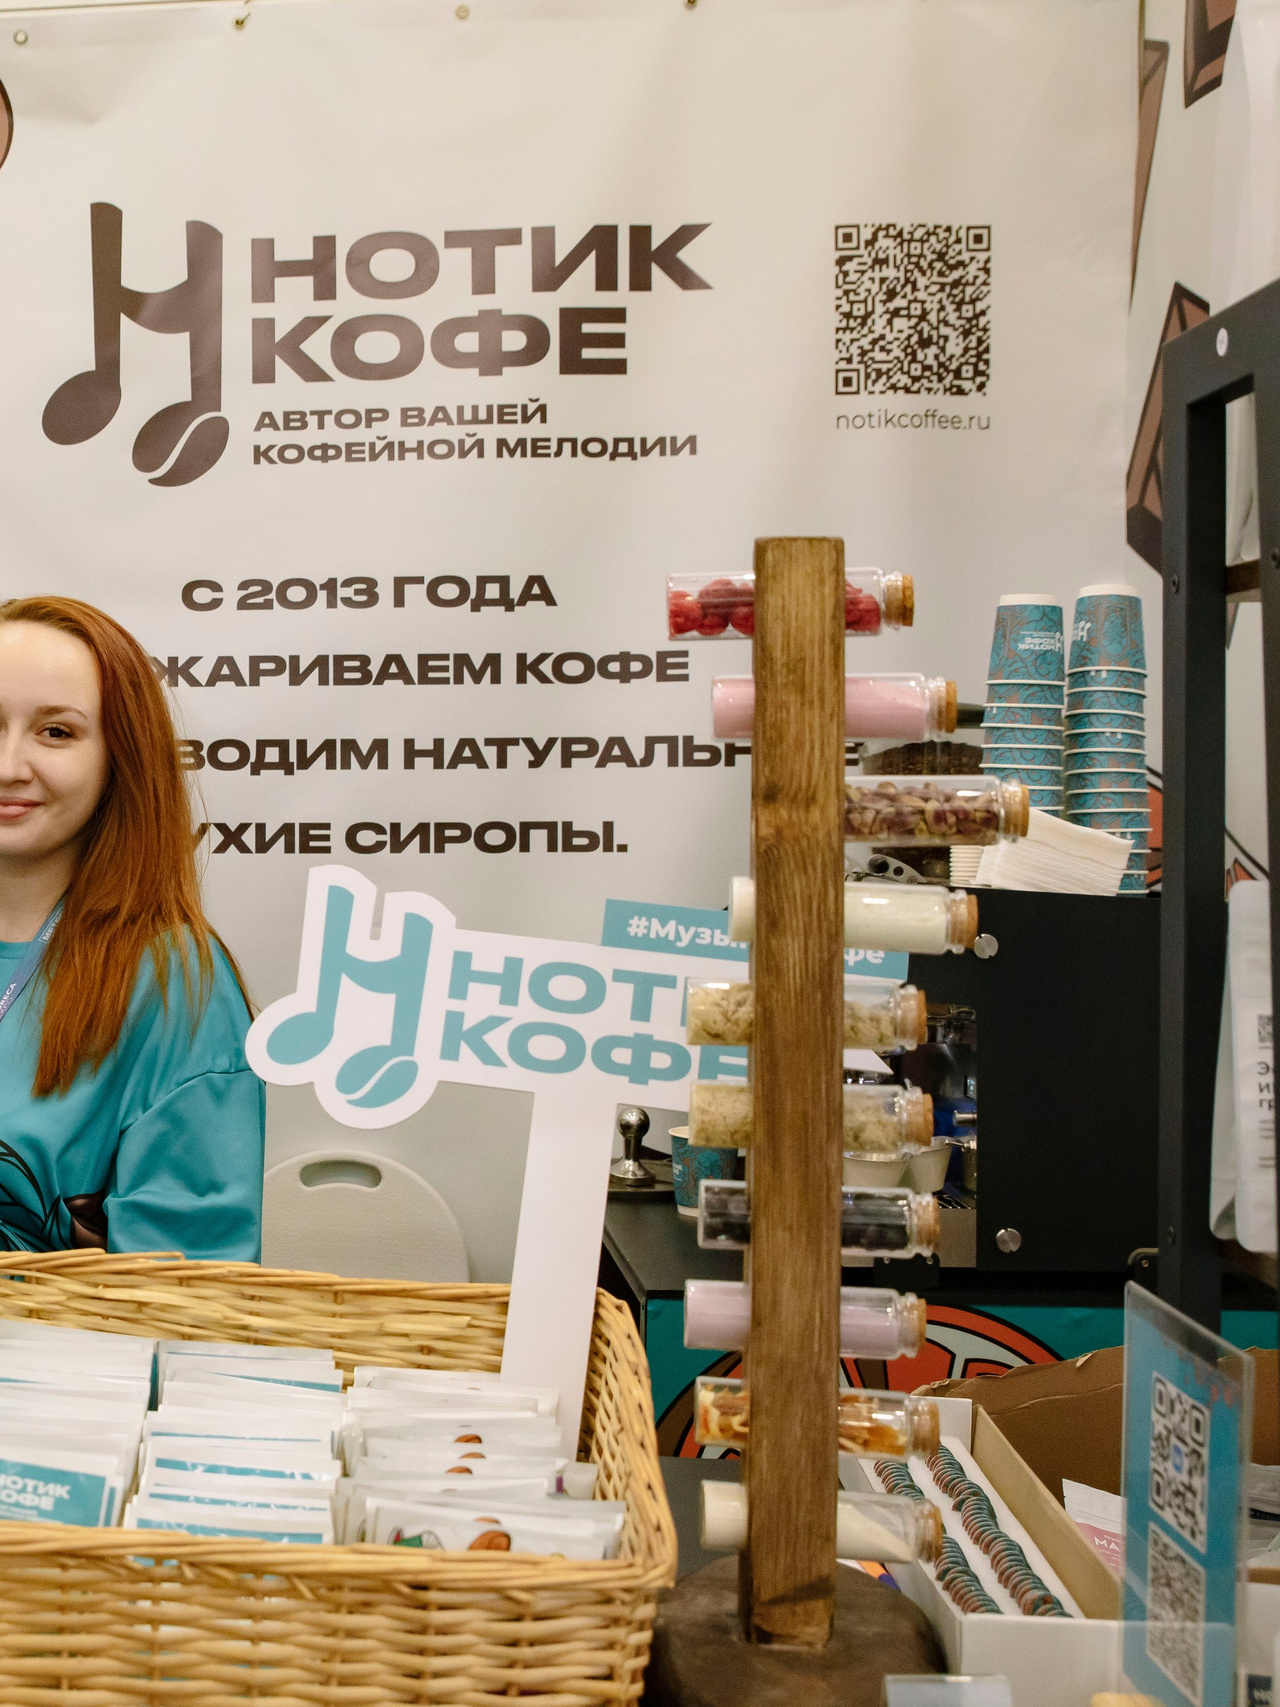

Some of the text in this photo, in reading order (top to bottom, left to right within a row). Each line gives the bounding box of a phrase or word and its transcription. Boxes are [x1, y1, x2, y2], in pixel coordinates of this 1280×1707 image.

[251, 222, 713, 304] НОТИК
[251, 306, 628, 385] КОФЕ
[253, 398, 548, 433] АВТОР ВАШЕЙ
[836, 410, 991, 434] notikcoffee.ru
[253, 433, 698, 465] КОФЕЙНОЙ МЕЛОДИИ
[182, 574, 558, 613] С 2013 ГОДА
[152, 648, 689, 688] ЖАРИВАЕМ КОФЕ
[176, 738, 389, 776] ВОДИМ
[404, 734, 864, 775] НАТУРАЛЬН
[192, 819, 629, 855] УХИЕ СИРОПЫ.
[448, 950, 688, 1027] НОТ
